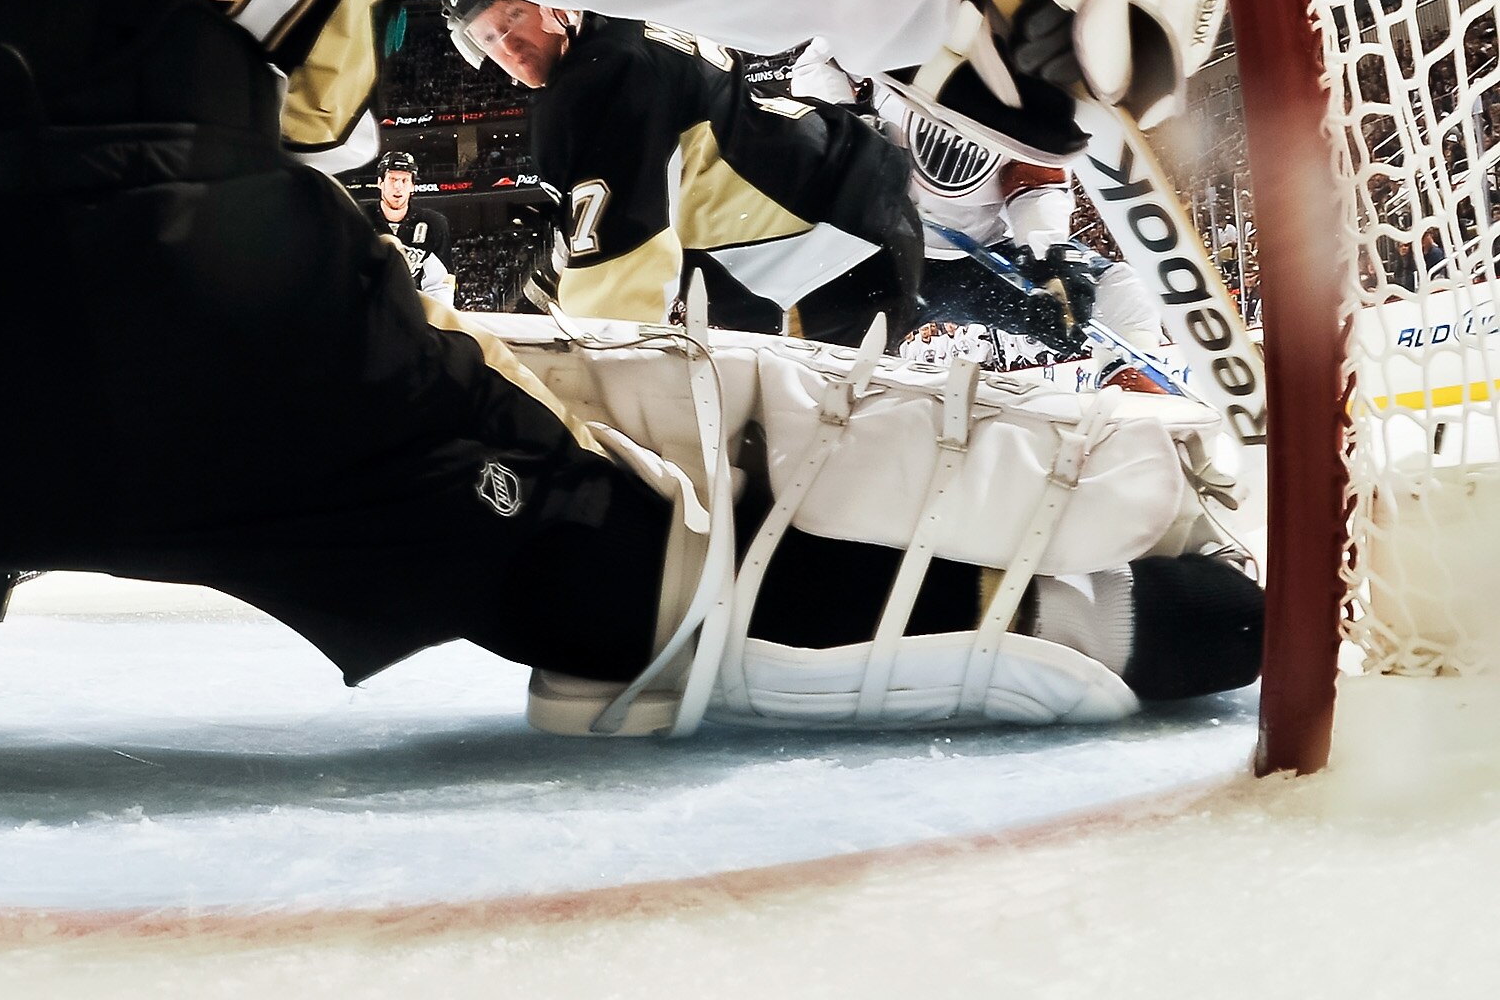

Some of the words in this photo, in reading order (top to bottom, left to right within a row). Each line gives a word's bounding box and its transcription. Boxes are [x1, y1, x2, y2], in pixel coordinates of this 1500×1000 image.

[745, 70, 774, 84] GUINS
[395, 116, 417, 126] Pizza
[414, 183, 440, 193] NSOL
[515, 174, 540, 188] Pizz
[1086, 139, 1268, 446] Reebok
